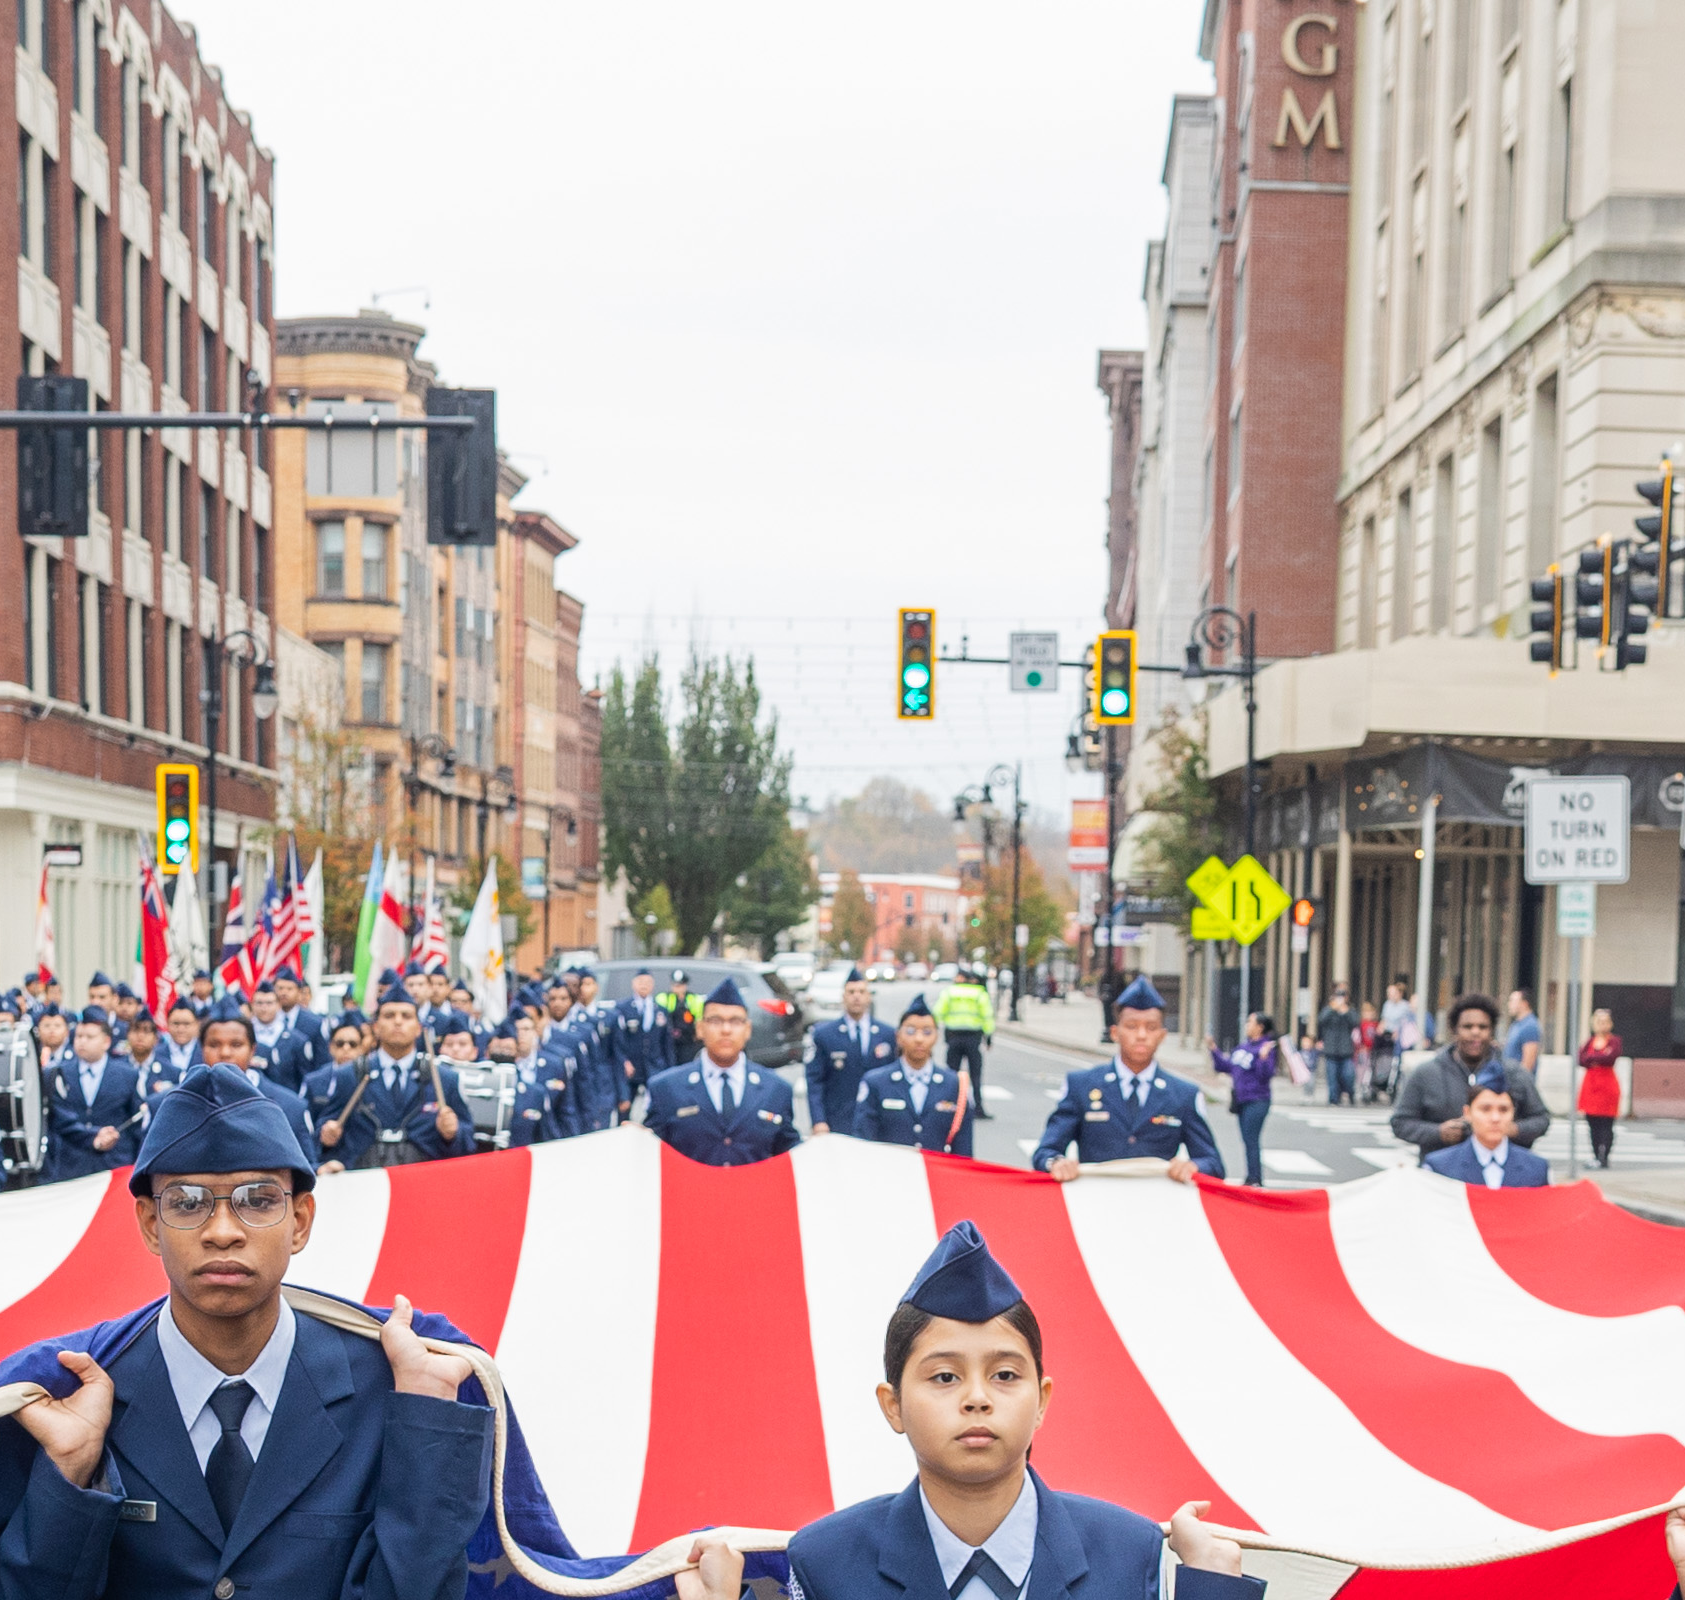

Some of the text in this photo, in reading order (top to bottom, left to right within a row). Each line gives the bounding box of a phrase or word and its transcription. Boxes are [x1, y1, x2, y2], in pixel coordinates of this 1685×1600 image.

[1559, 792, 1594, 812] NO
[1550, 820, 1606, 839] TURN
[1536, 848, 1617, 868] ON RED
